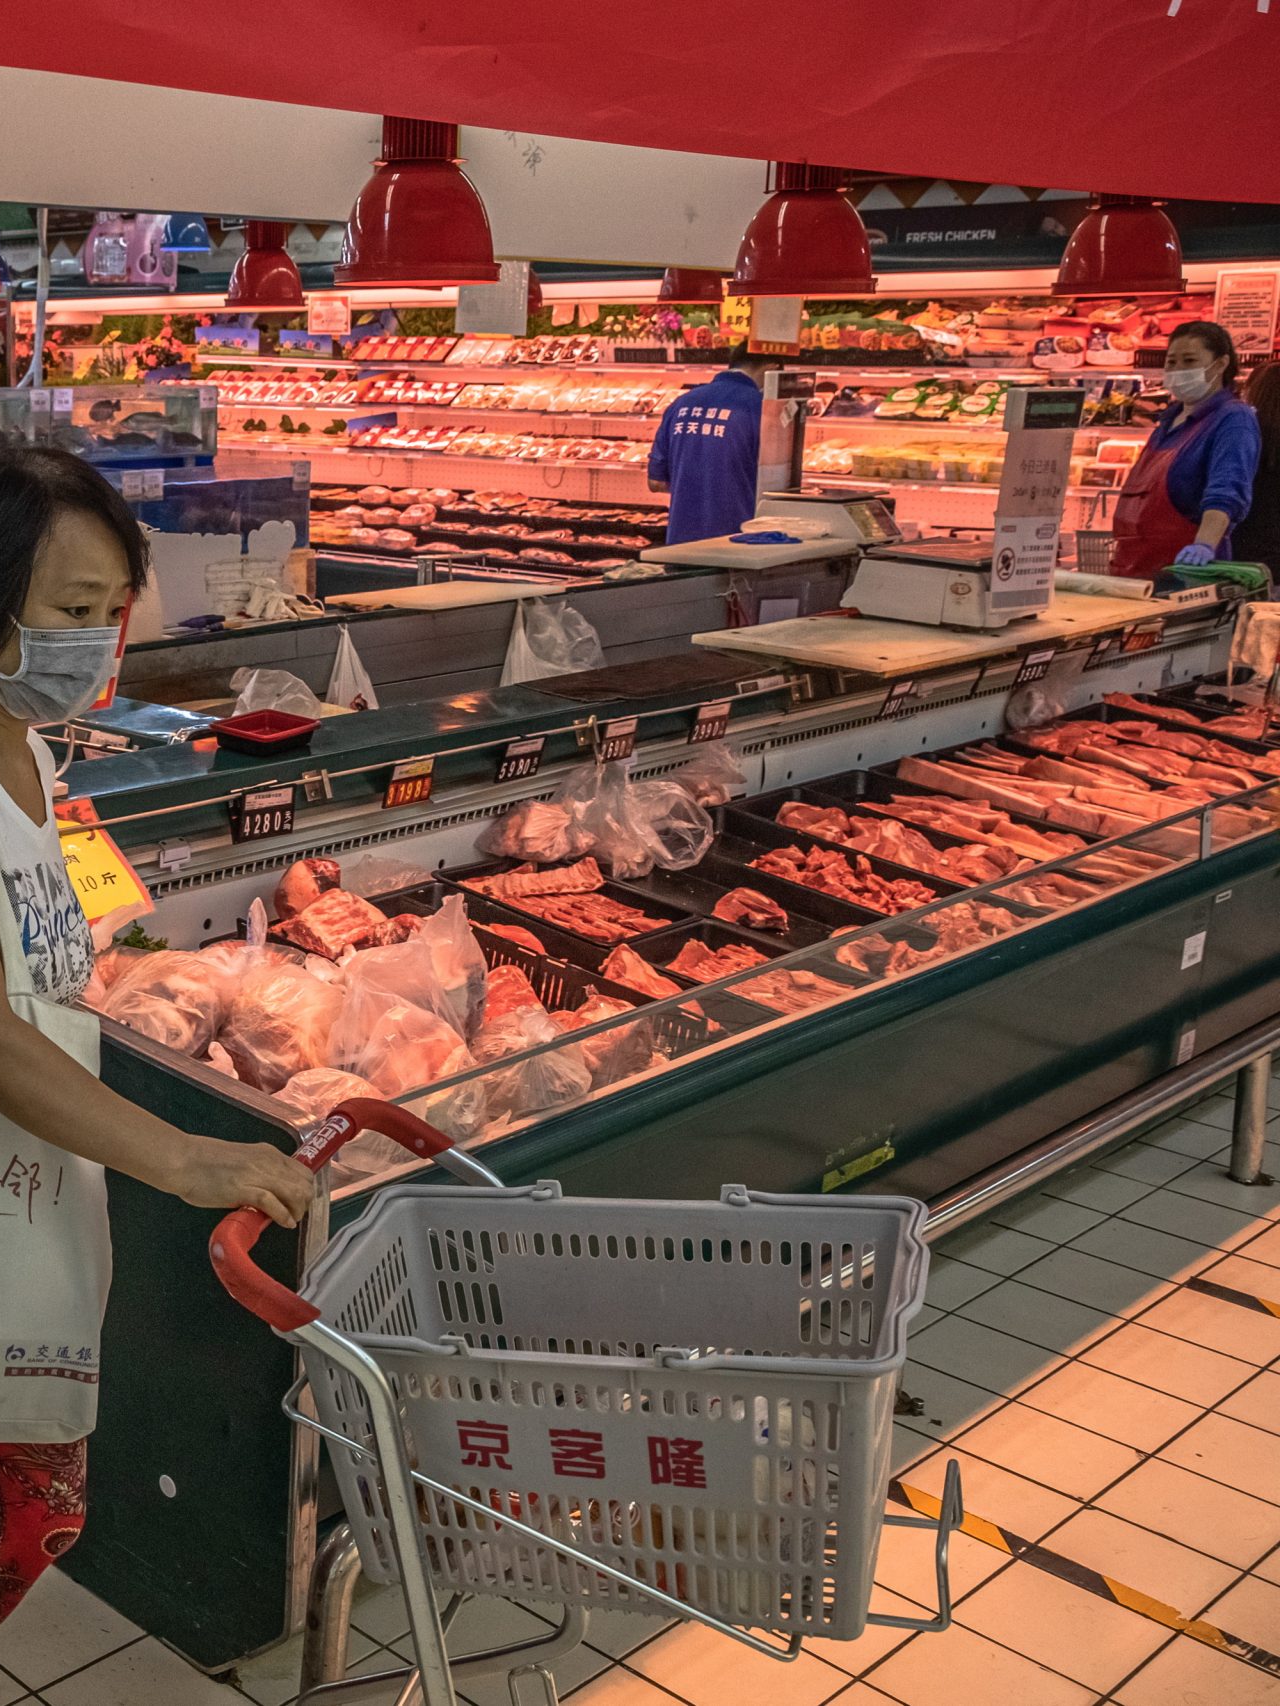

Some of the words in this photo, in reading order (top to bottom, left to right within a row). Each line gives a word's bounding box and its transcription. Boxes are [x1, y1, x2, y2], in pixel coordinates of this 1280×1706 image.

[906, 231, 943, 244] FRESH
[945, 229, 996, 242] CHICKEN
[35, 1344, 100, 1362] 交通銀
[455, 1418, 709, 1490] 京客隆
